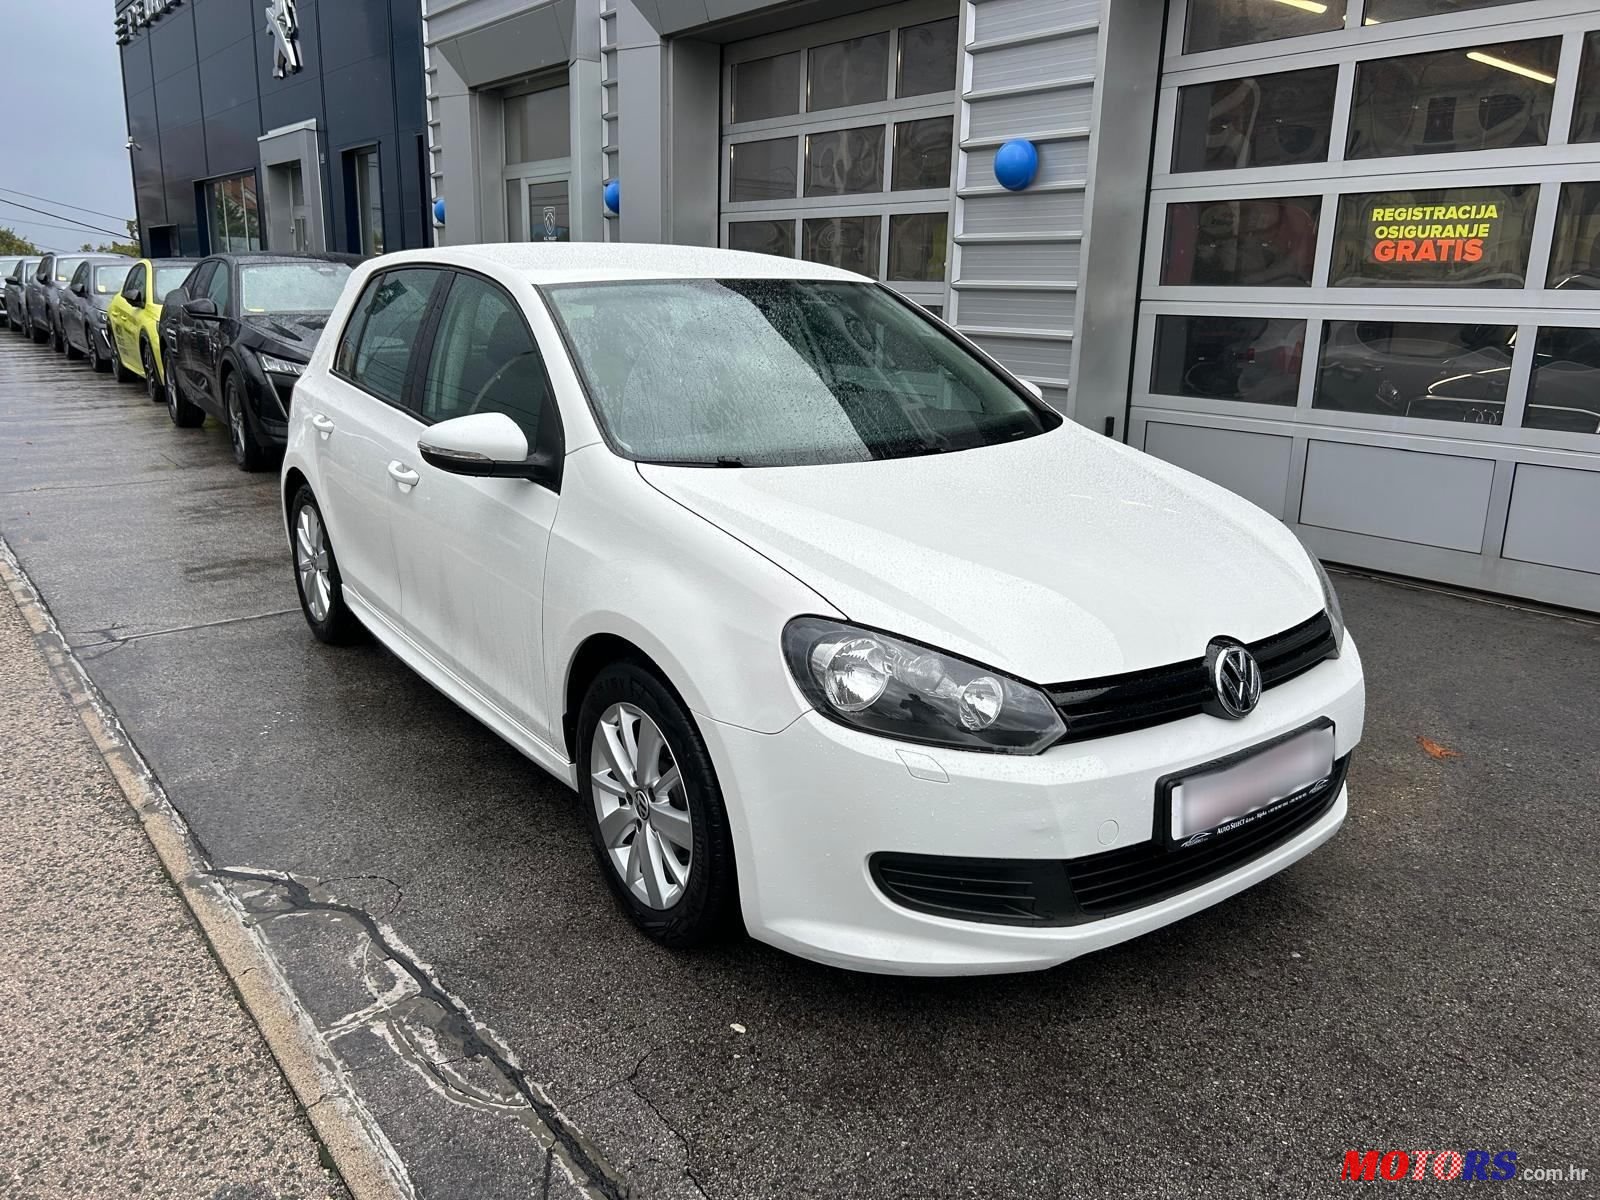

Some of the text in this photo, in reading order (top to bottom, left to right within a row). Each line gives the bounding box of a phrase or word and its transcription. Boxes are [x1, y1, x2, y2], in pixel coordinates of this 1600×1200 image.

[1372, 204, 1498, 222] REGISTRACIJA
[1374, 223, 1490, 239] OSIGURANJE
[1374, 238, 1484, 262] GRATIS
